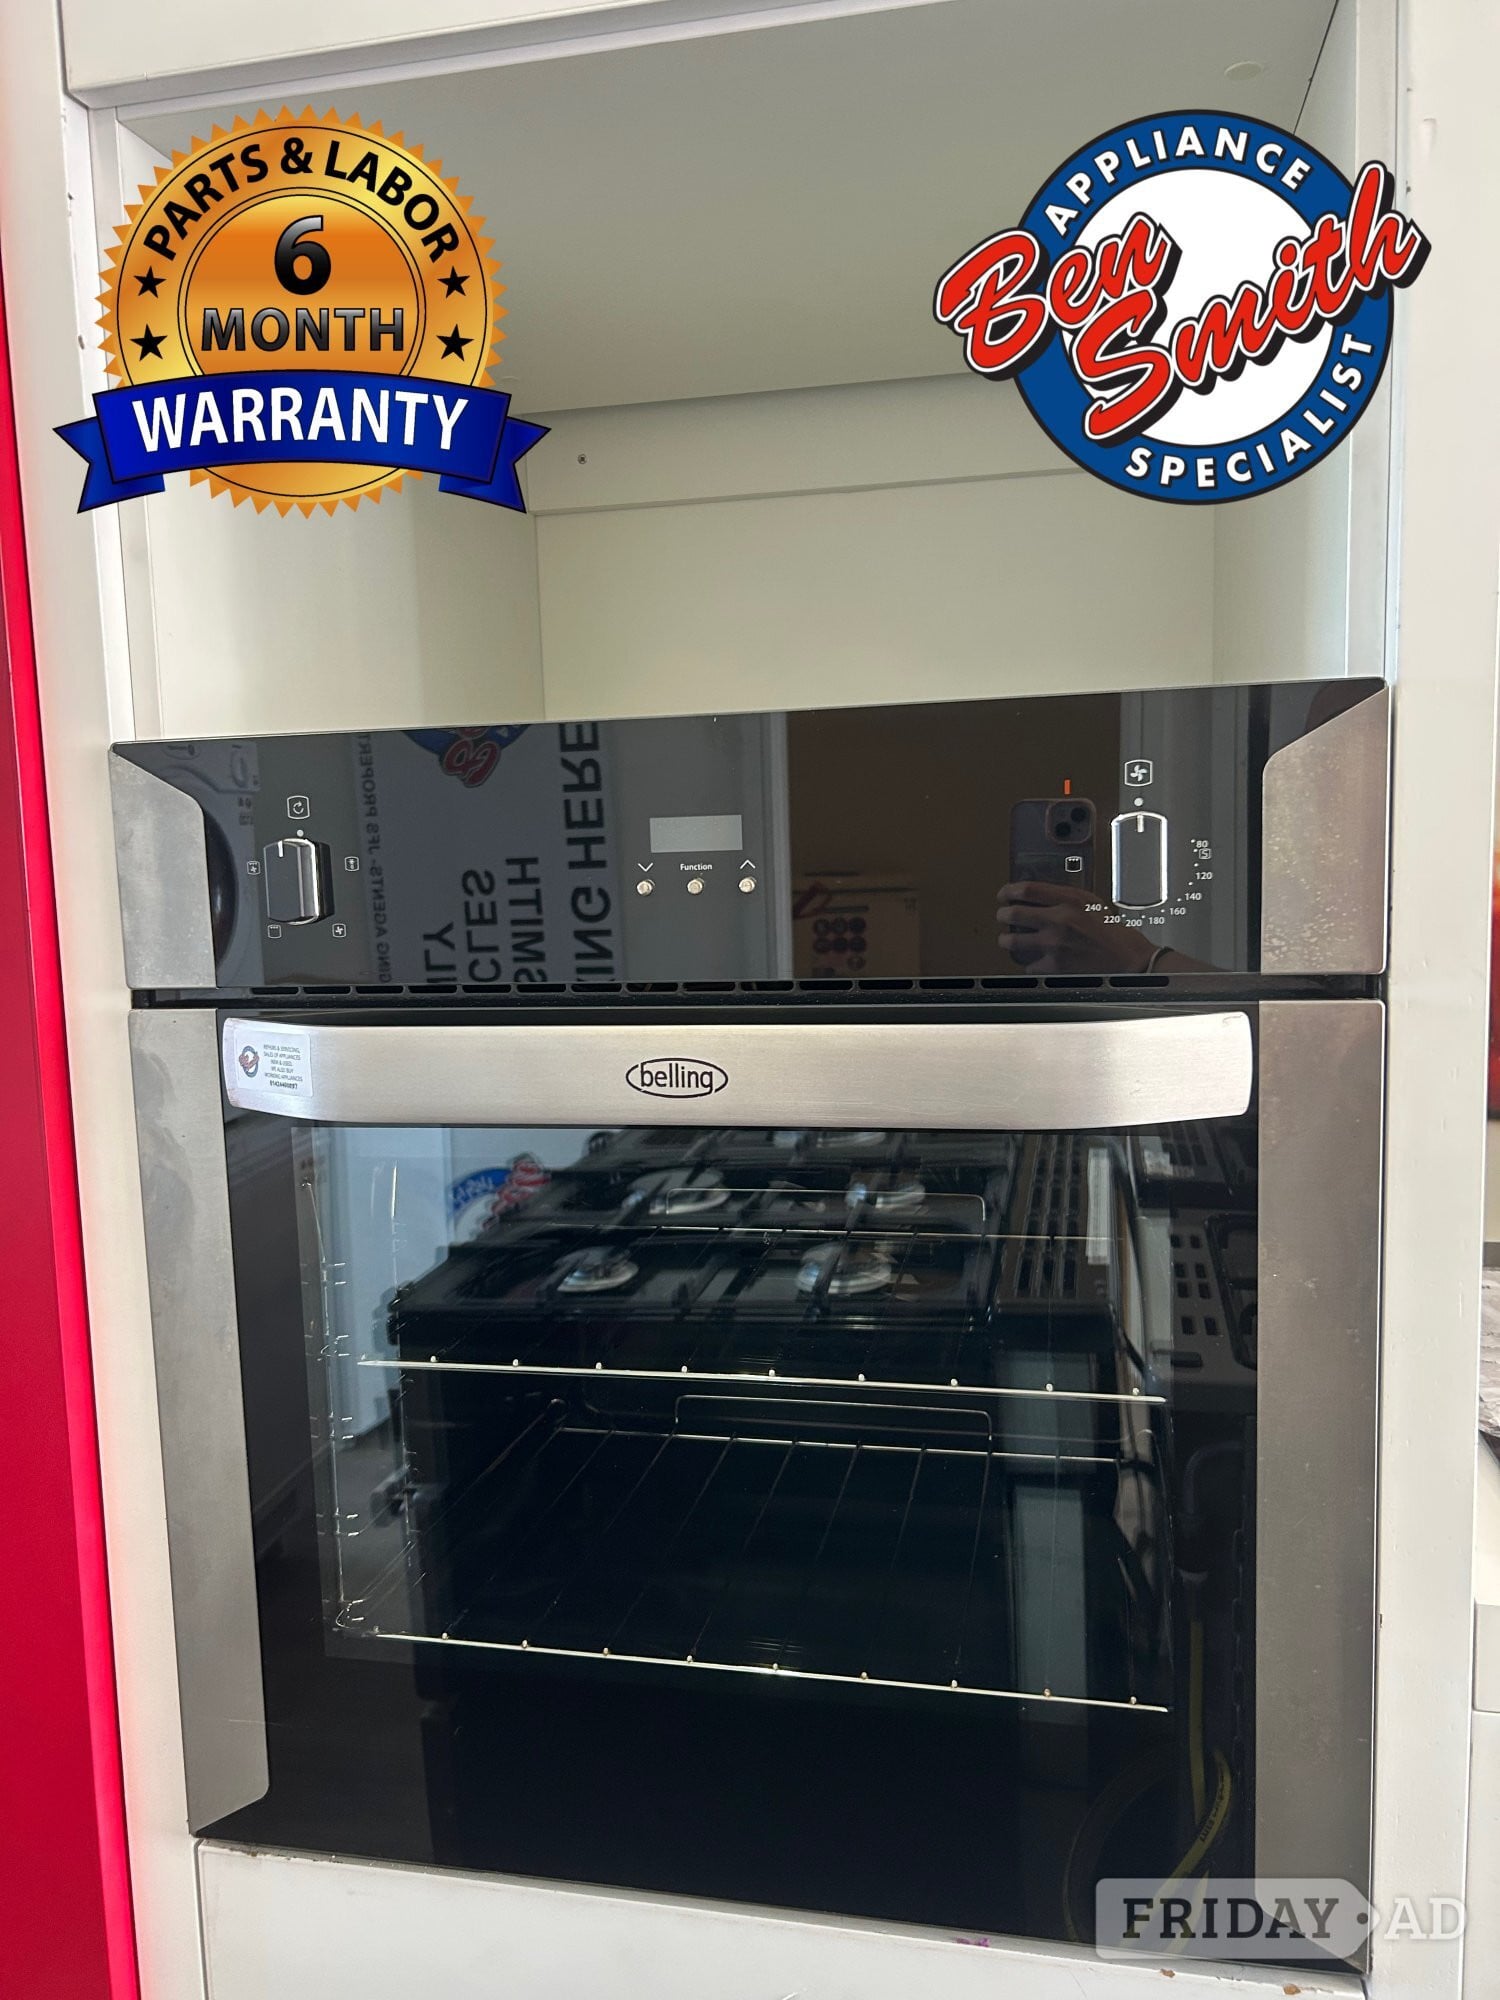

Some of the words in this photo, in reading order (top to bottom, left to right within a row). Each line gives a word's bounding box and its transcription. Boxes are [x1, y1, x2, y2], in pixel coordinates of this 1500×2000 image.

[1196, 840, 1208, 848] 80
[680, 863, 713, 871] Function
[1195, 871, 1213, 880] 120
[1185, 892, 1202, 900] 140
[1084, 903, 1102, 912] 240
[1169, 907, 1186, 915] 160
[1103, 915, 1121, 924] 220
[1125, 919, 1143, 927] 200
[1148, 916, 1165, 925] 180
[640, 1062, 714, 1094] belling
